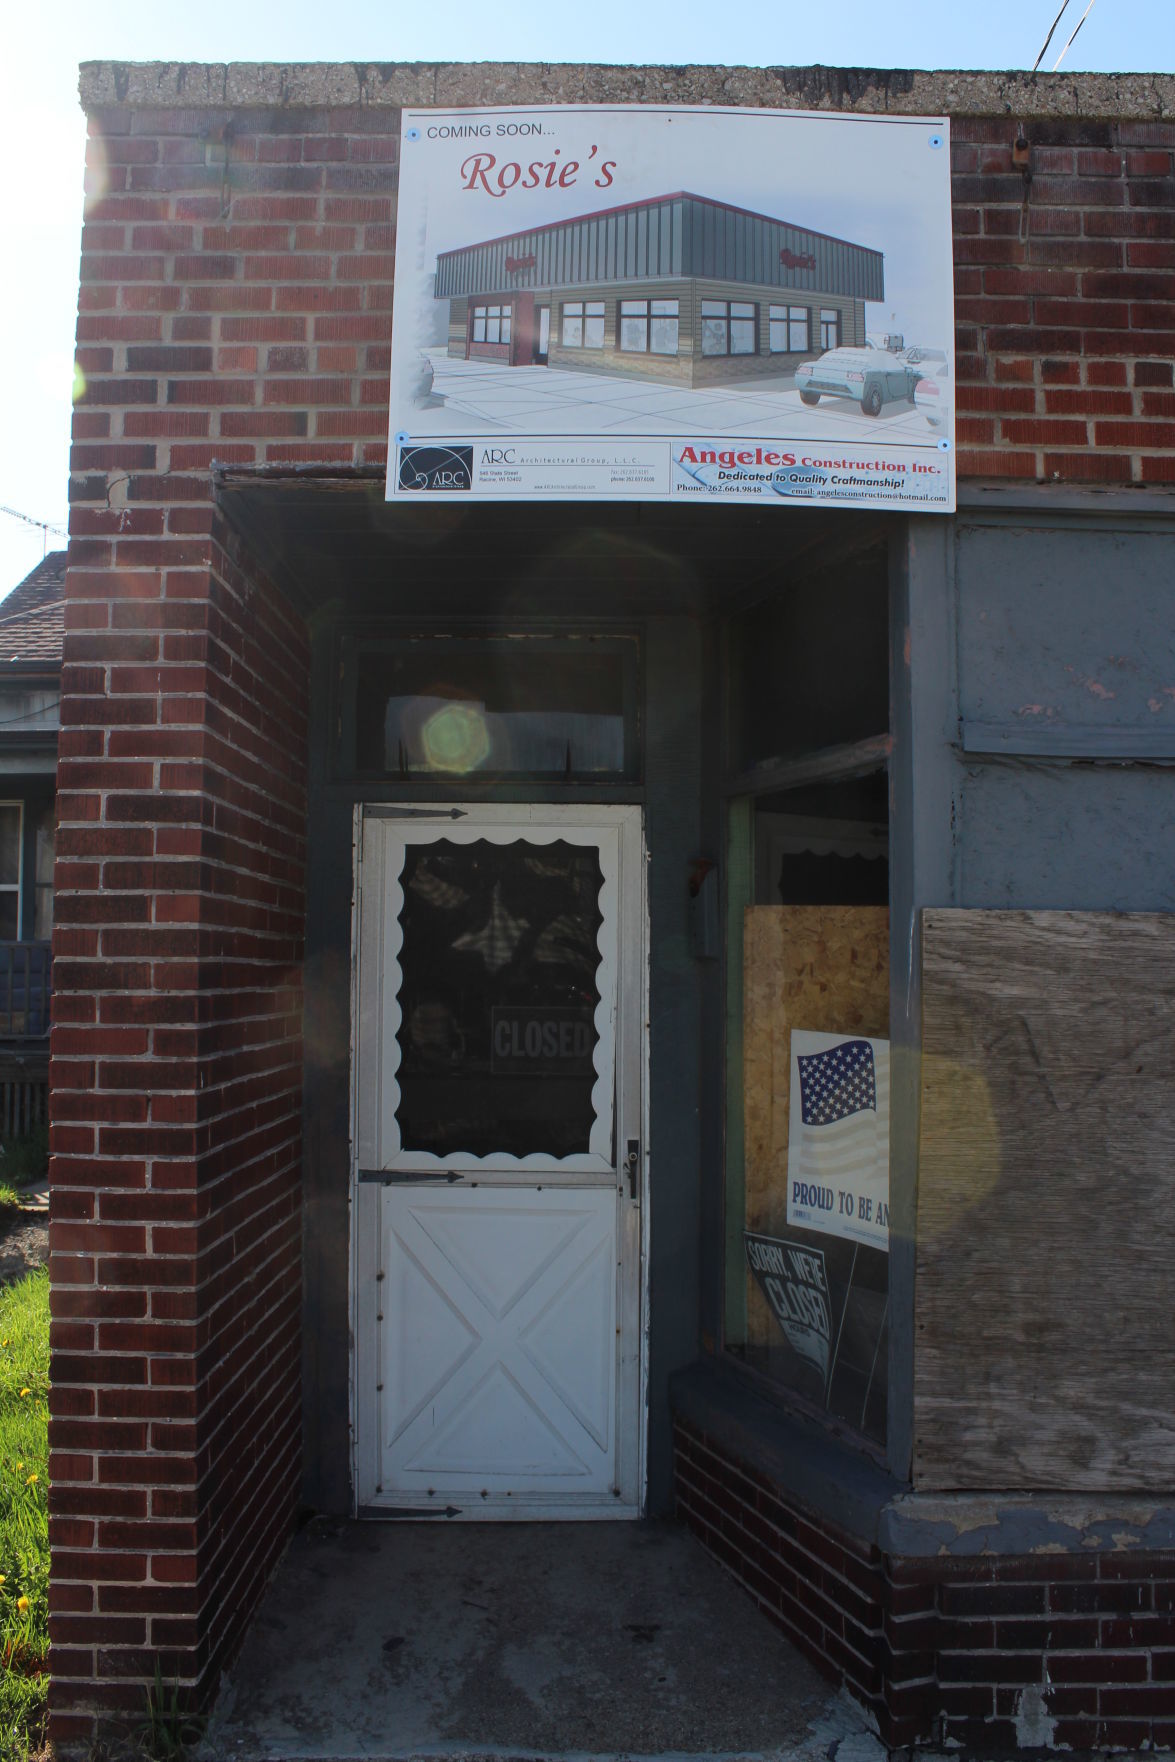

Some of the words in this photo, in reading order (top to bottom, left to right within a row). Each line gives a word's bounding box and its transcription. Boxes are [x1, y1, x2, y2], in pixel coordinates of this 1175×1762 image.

[427, 125, 491, 139] COMING
[496, 123, 555, 137] SOON...
[460, 144, 617, 198] Rosie's
[481, 449, 516, 464] ARC
[520, 456, 579, 465] Architectural
[679, 446, 797, 469] Angeles
[801, 457, 906, 473] Construction
[912, 463, 942, 475] Inc.
[432, 471, 464, 484] ARC
[677, 484, 705, 493] Phone:
[718, 471, 773, 482] Dedicated
[775, 472, 786, 482] to
[790, 473, 828, 486] Quality
[831, 475, 905, 489] Craftmanship!
[494, 1019, 590, 1059] CLOSED
[792, 1181, 834, 1211] PROUD
[838, 1190, 854, 1217] TO
[858, 1196, 873, 1222] BE
[764, 1276, 830, 1342] CLOSED
